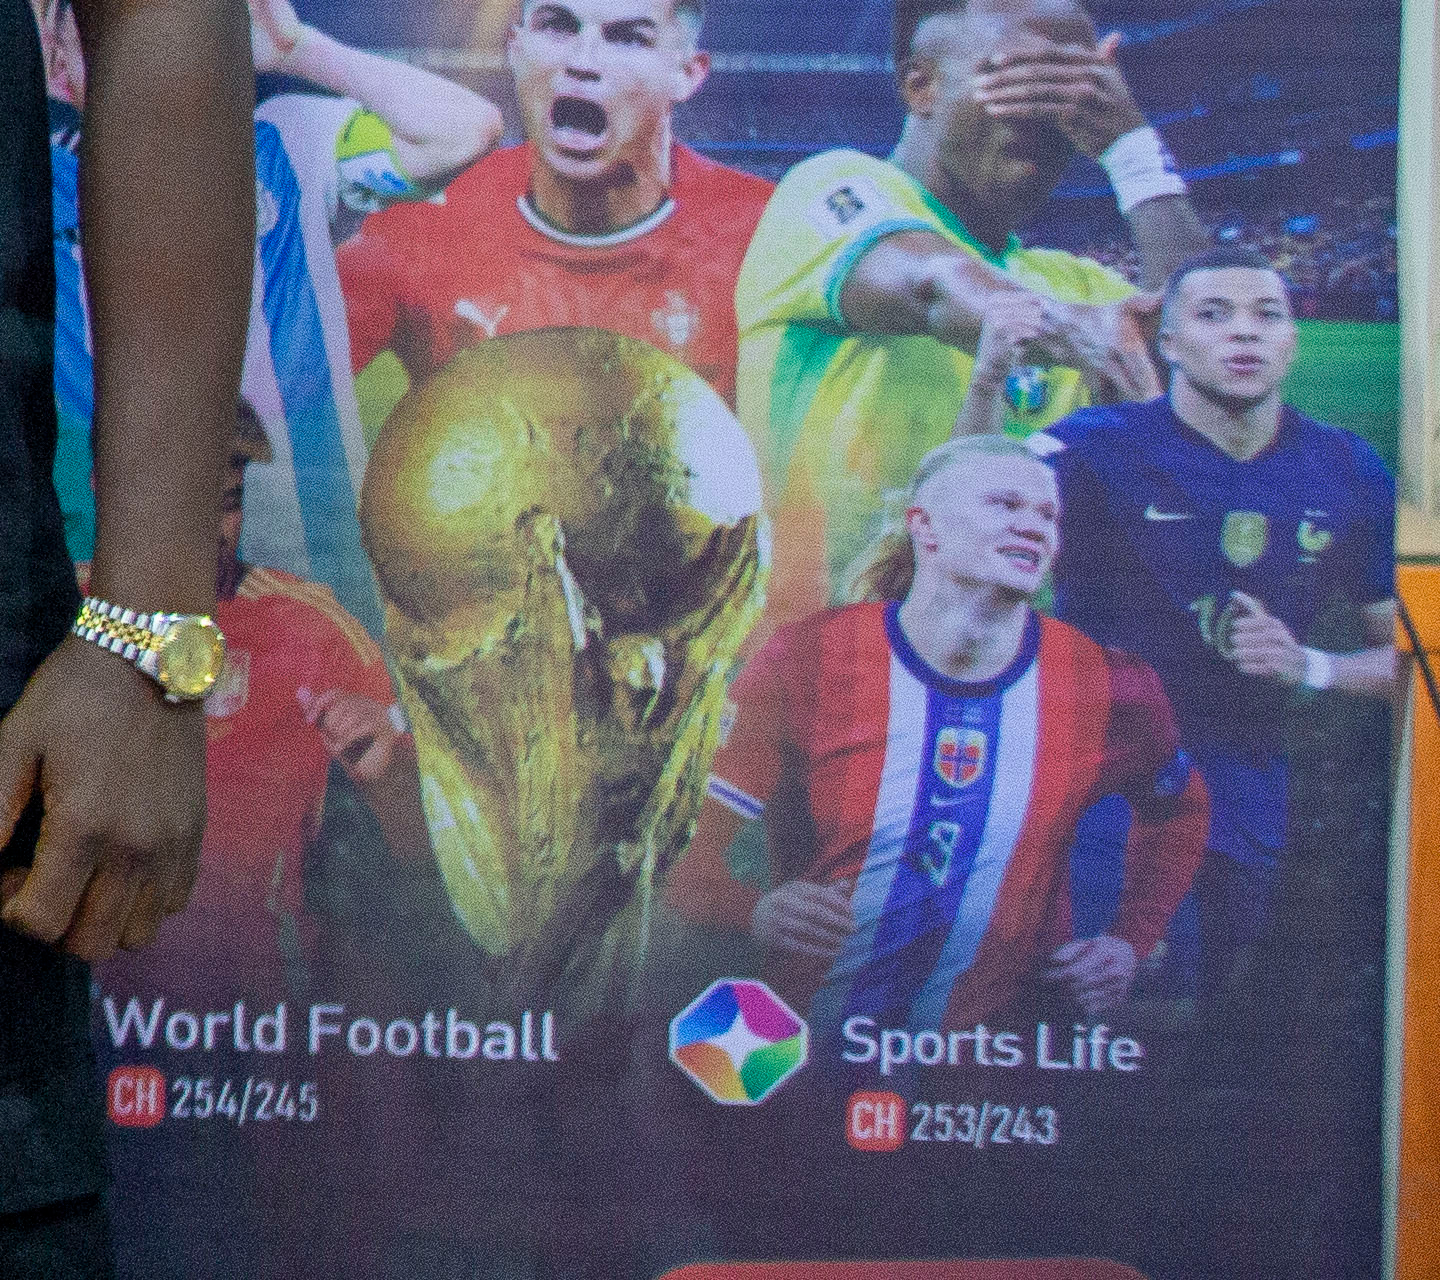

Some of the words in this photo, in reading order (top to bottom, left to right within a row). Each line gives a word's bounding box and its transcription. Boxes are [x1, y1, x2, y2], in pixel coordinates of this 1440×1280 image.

[103, 996, 288, 1053] World
[307, 1003, 560, 1063] Football
[840, 1015, 1024, 1075] Sports
[1036, 1022, 1144, 1072] Life
[113, 1075, 158, 1117] CH
[170, 1075, 319, 1125] 254/245
[851, 1100, 899, 1139] CH
[910, 1100, 1058, 1147] 253/243
